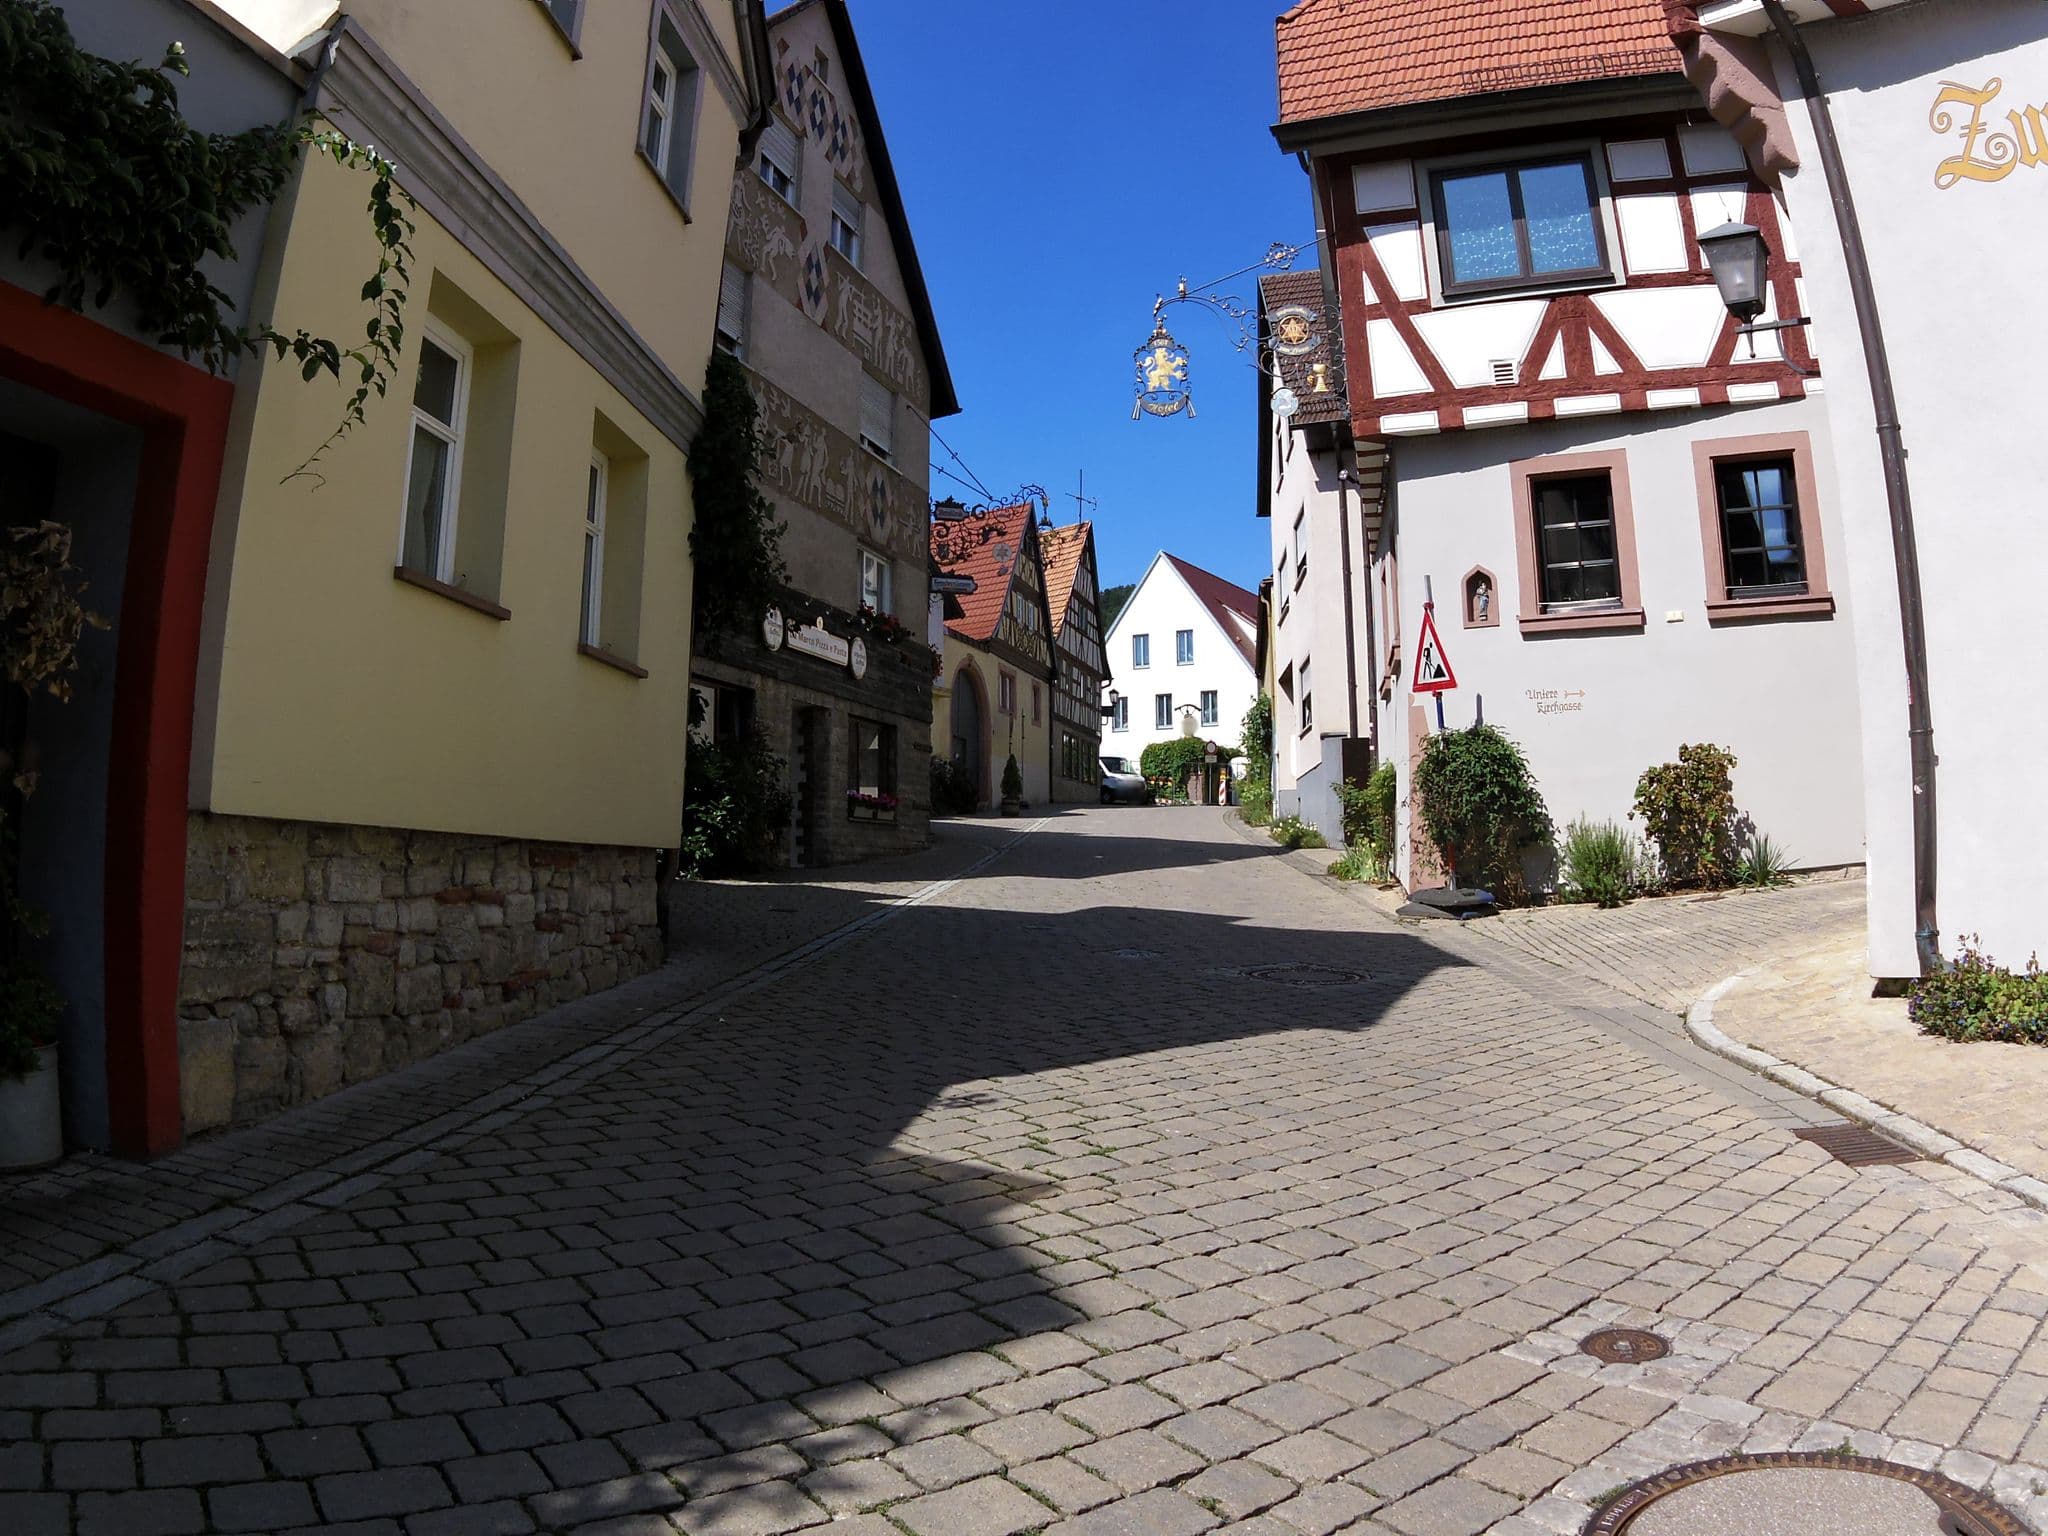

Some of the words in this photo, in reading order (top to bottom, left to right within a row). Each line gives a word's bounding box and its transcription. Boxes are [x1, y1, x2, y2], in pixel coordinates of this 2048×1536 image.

[1929, 77, 2048, 190] Zu
[1148, 401, 1179, 414] Hotel
[815, 638, 829, 651] Pizza
[833, 645, 847, 657] Pasta
[1525, 689, 1558, 700] Untere
[1536, 701, 1583, 714] Kirchgasse
